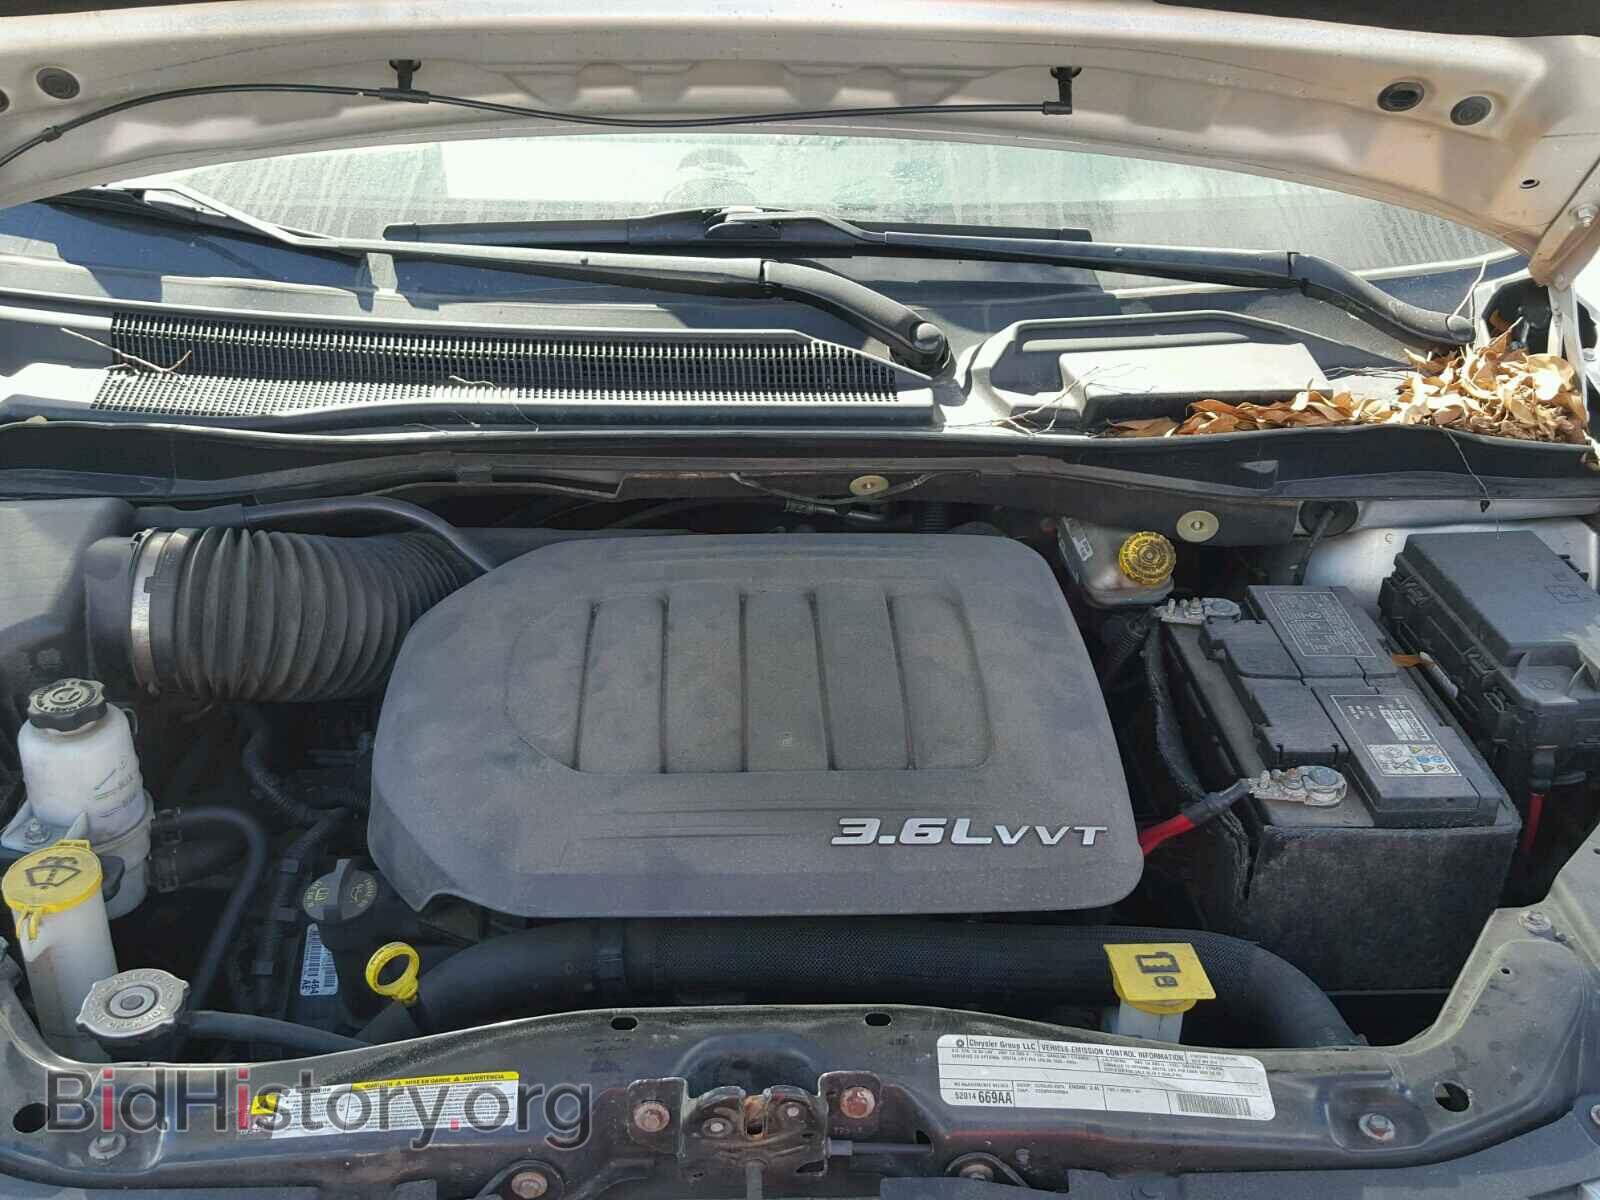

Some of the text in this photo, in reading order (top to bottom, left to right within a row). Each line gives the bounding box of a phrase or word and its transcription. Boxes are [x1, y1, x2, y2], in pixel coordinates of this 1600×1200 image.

[831, 817, 1108, 846] 3.6L VVT
[968, 1039, 998, 1049] Chrysler
[999, 1040, 1020, 1051] Group
[1022, 1042, 1036, 1051] LLC
[1041, 1043, 1069, 1052] VEHICLE
[1071, 1045, 1104, 1056] EMISSION
[1105, 1048, 1136, 1058] CONTROL
[1138, 1051, 1185, 1062] INFORMATION
[978, 1091, 1013, 1105] 669AA
